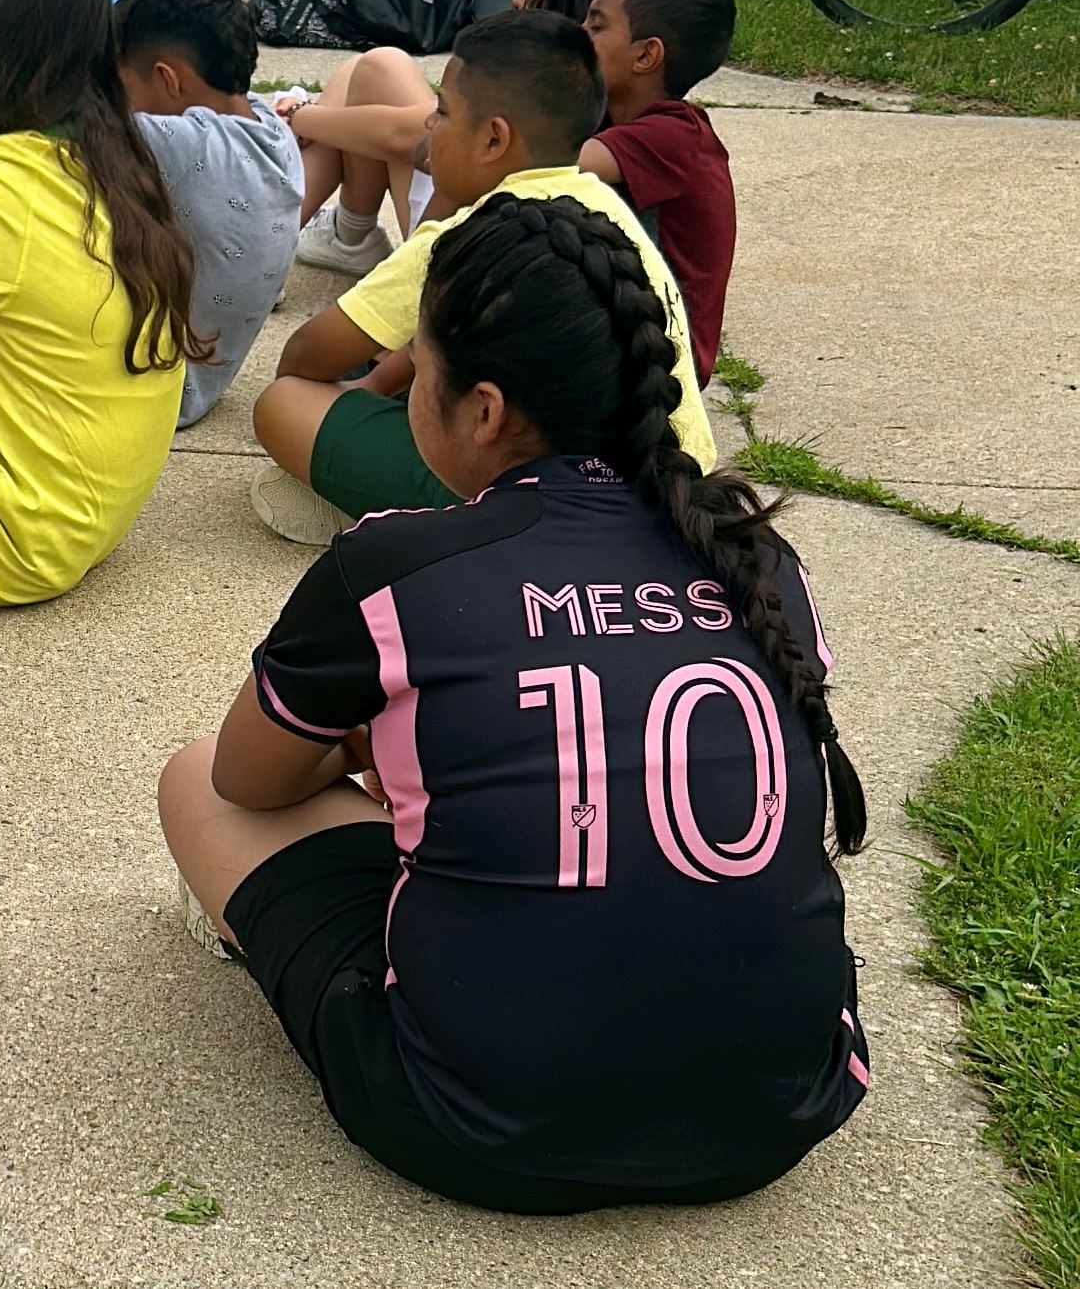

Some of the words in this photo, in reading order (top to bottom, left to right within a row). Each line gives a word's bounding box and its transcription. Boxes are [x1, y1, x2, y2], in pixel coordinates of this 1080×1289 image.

[600, 468, 614, 477] TO
[522, 580, 751, 637] MESS
[518, 656, 788, 887] 10
